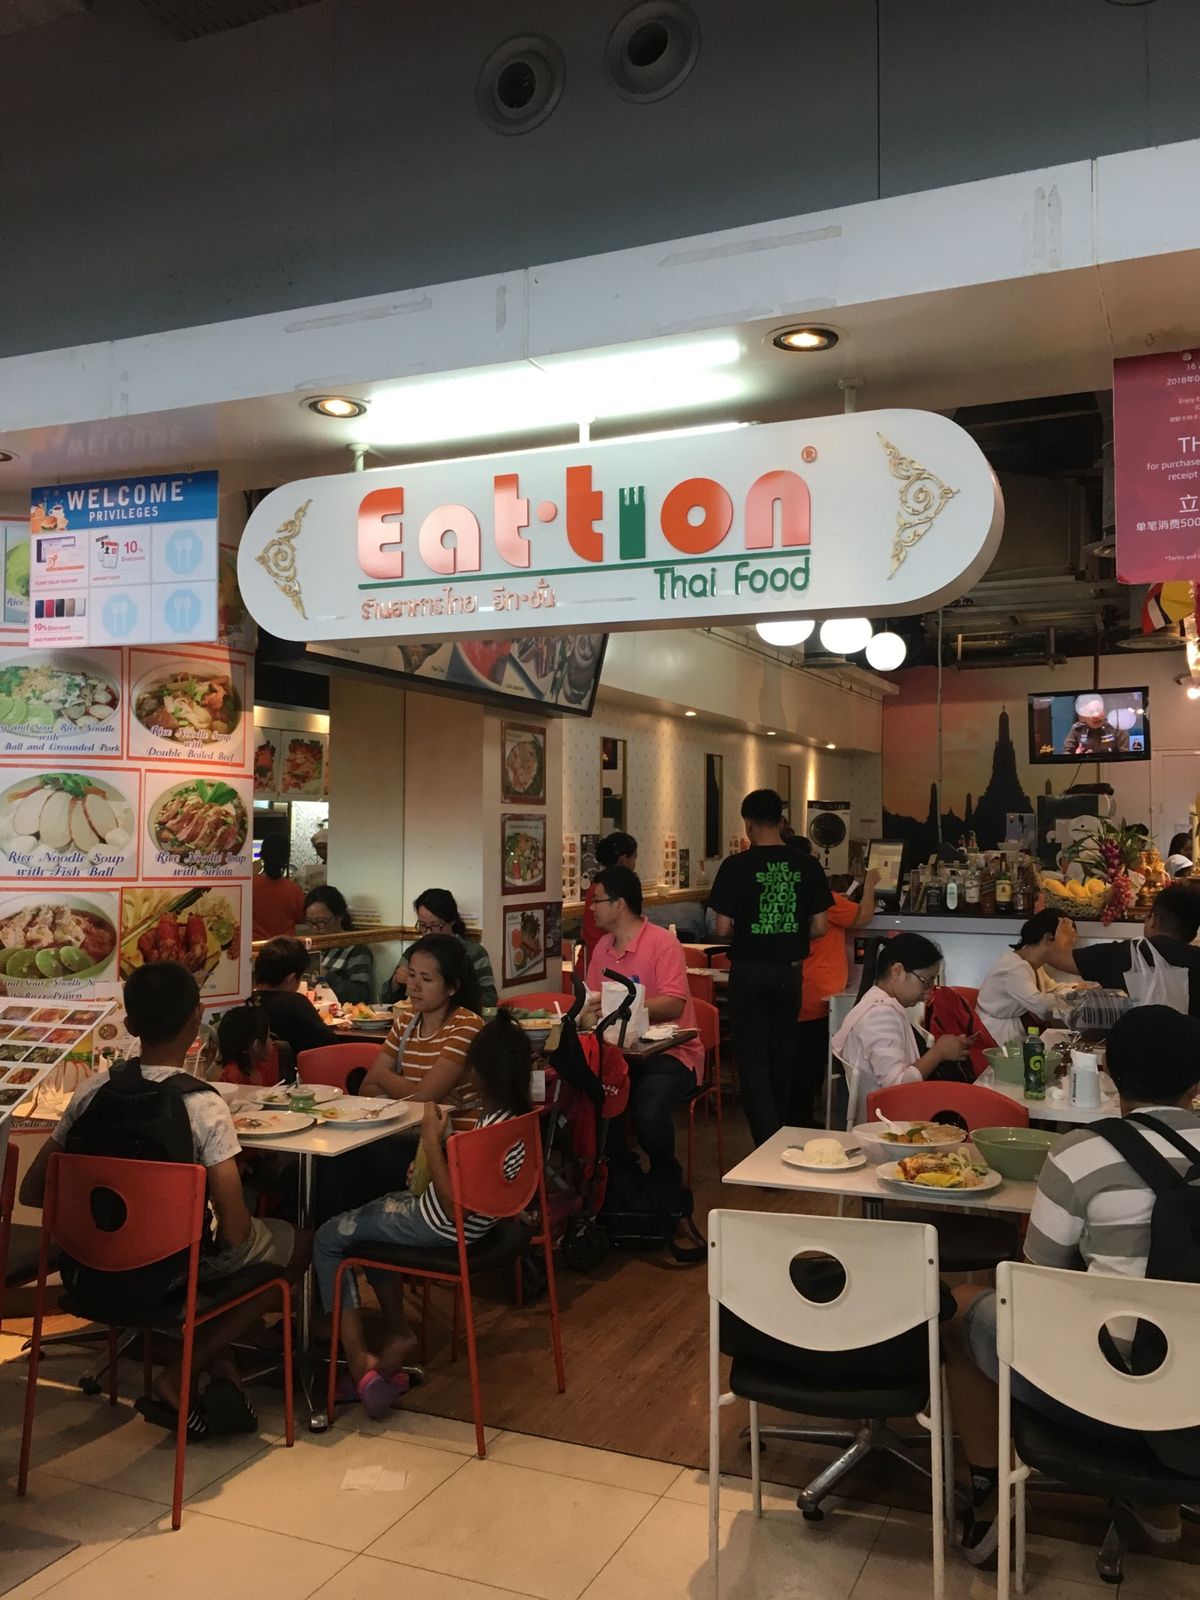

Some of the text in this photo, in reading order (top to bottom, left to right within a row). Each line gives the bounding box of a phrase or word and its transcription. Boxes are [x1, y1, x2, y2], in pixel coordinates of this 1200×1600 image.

[1147, 462, 1160, 473] for
[1168, 470, 1199, 481] receipt
[67, 480, 184, 510] WELCOME
[89, 506, 158, 522] PRIVILEGES
[653, 556, 811, 600] Thai Food
[152, 725, 172, 736] Rice
[39, 733, 59, 741] with
[5, 742, 120, 752] Ball and Grounded Pork
[147, 747, 181, 757] Double
[188, 749, 215, 760] Boiled
[9, 851, 125, 865] Rice Noodle Soup
[156, 851, 180, 864] Rice
[17, 864, 115, 876] with Fish Ball
[174, 866, 197, 876] with
[767, 862, 789, 872] WE
[756, 872, 801, 882] SERVE
[763, 882, 795, 893] THAI
[760, 892, 797, 902] FOOD
[760, 902, 796, 913] WITH
[759, 912, 794, 924] SIAM
[751, 923, 799, 935] SMILES
